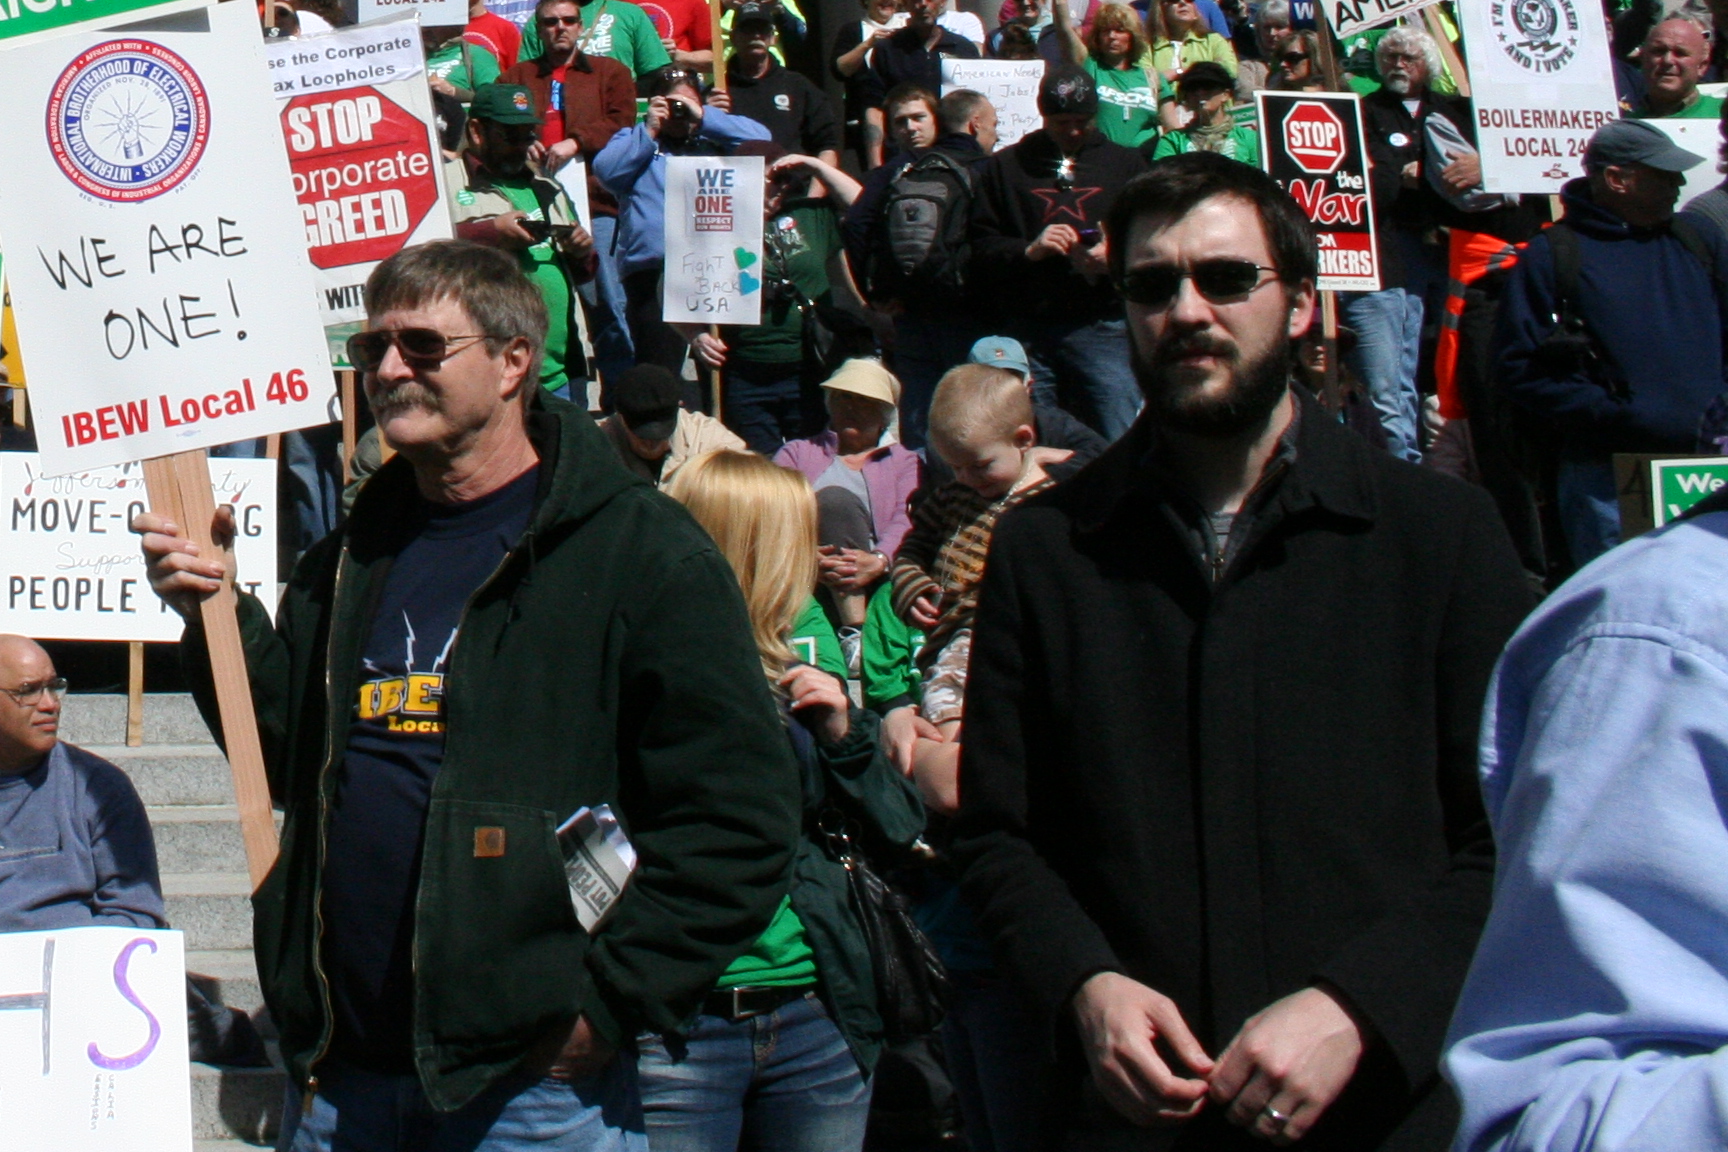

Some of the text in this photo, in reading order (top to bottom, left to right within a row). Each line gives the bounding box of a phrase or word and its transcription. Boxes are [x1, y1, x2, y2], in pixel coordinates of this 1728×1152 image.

[291, 35, 412, 66] the Corporate
[1505, 44, 1575, 73] AND VOTE
[133, 61, 150, 75] OF
[273, 62, 396, 93] ax Loopholes
[67, 59, 130, 117] BROTHERHOOD
[149, 66, 189, 127] ELECTRICAL
[287, 96, 383, 153] STOP
[1289, 121, 1337, 148] STOP
[1478, 108, 1614, 129] BOILERMAKERS
[67, 120, 132, 181] INTERNATIONAL
[144, 131, 189, 178] WORKERS
[1504, 137, 1563, 157] LOCAL
[292, 150, 430, 198] orporate
[696, 169, 735, 188] WE
[1336, 171, 1363, 189] the
[298, 189, 410, 248] GREED
[695, 195, 734, 214] ONE
[36, 216, 248, 290] WE ARE
[1318, 250, 1372, 276] RKERS
[104, 278, 248, 360] ONE!
[62, 368, 309, 448] IBEW Local 46
[9, 576, 137, 613] PEOPLE
